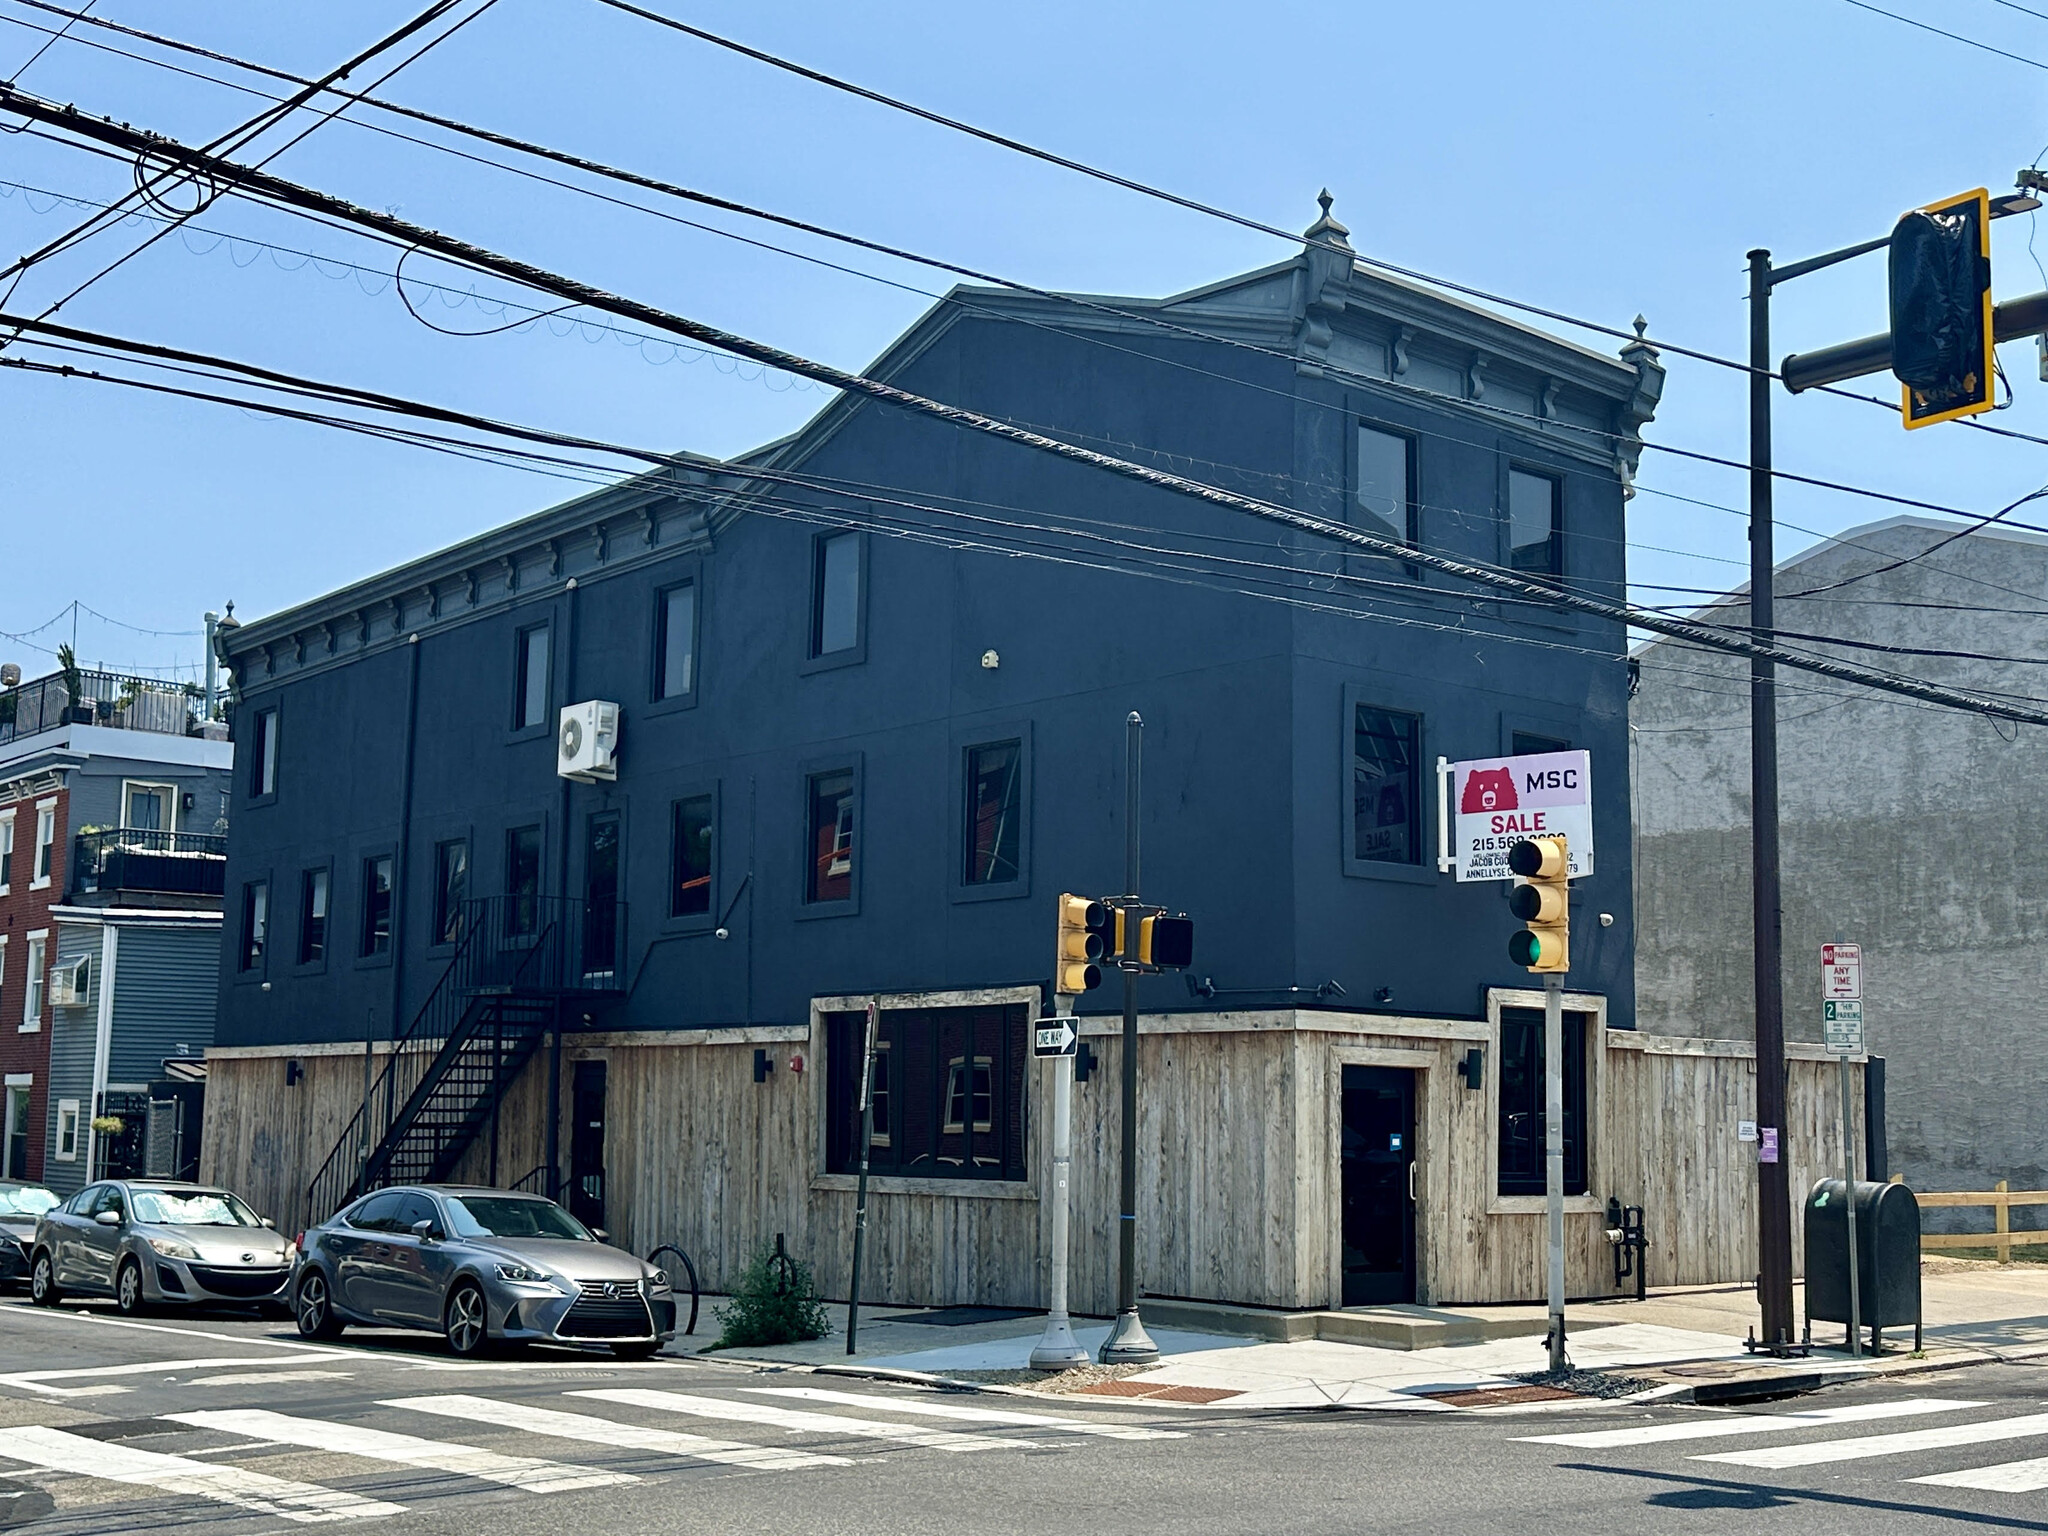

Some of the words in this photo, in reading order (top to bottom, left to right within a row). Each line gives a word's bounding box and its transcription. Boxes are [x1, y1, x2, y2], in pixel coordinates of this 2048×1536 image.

[1526, 769, 1577, 794] MSC
[1491, 812, 1546, 834] SALE
[1472, 832, 1566, 851] 215.568
[1469, 857, 1493, 867] JACOB
[1494, 856, 1509, 866] COO
[1466, 868, 1506, 879] ANNELLYSE
[1824, 950, 1834, 961] NO
[1834, 951, 1858, 959] PARKING
[1833, 967, 1850, 975] ANY
[1833, 976, 1851, 985] TIME
[1826, 1003, 1834, 1018] 2
[1836, 1011, 1860, 1019] PARKING
[1038, 1031, 1050, 1046] ONE
[1051, 1030, 1063, 1045] WAY
